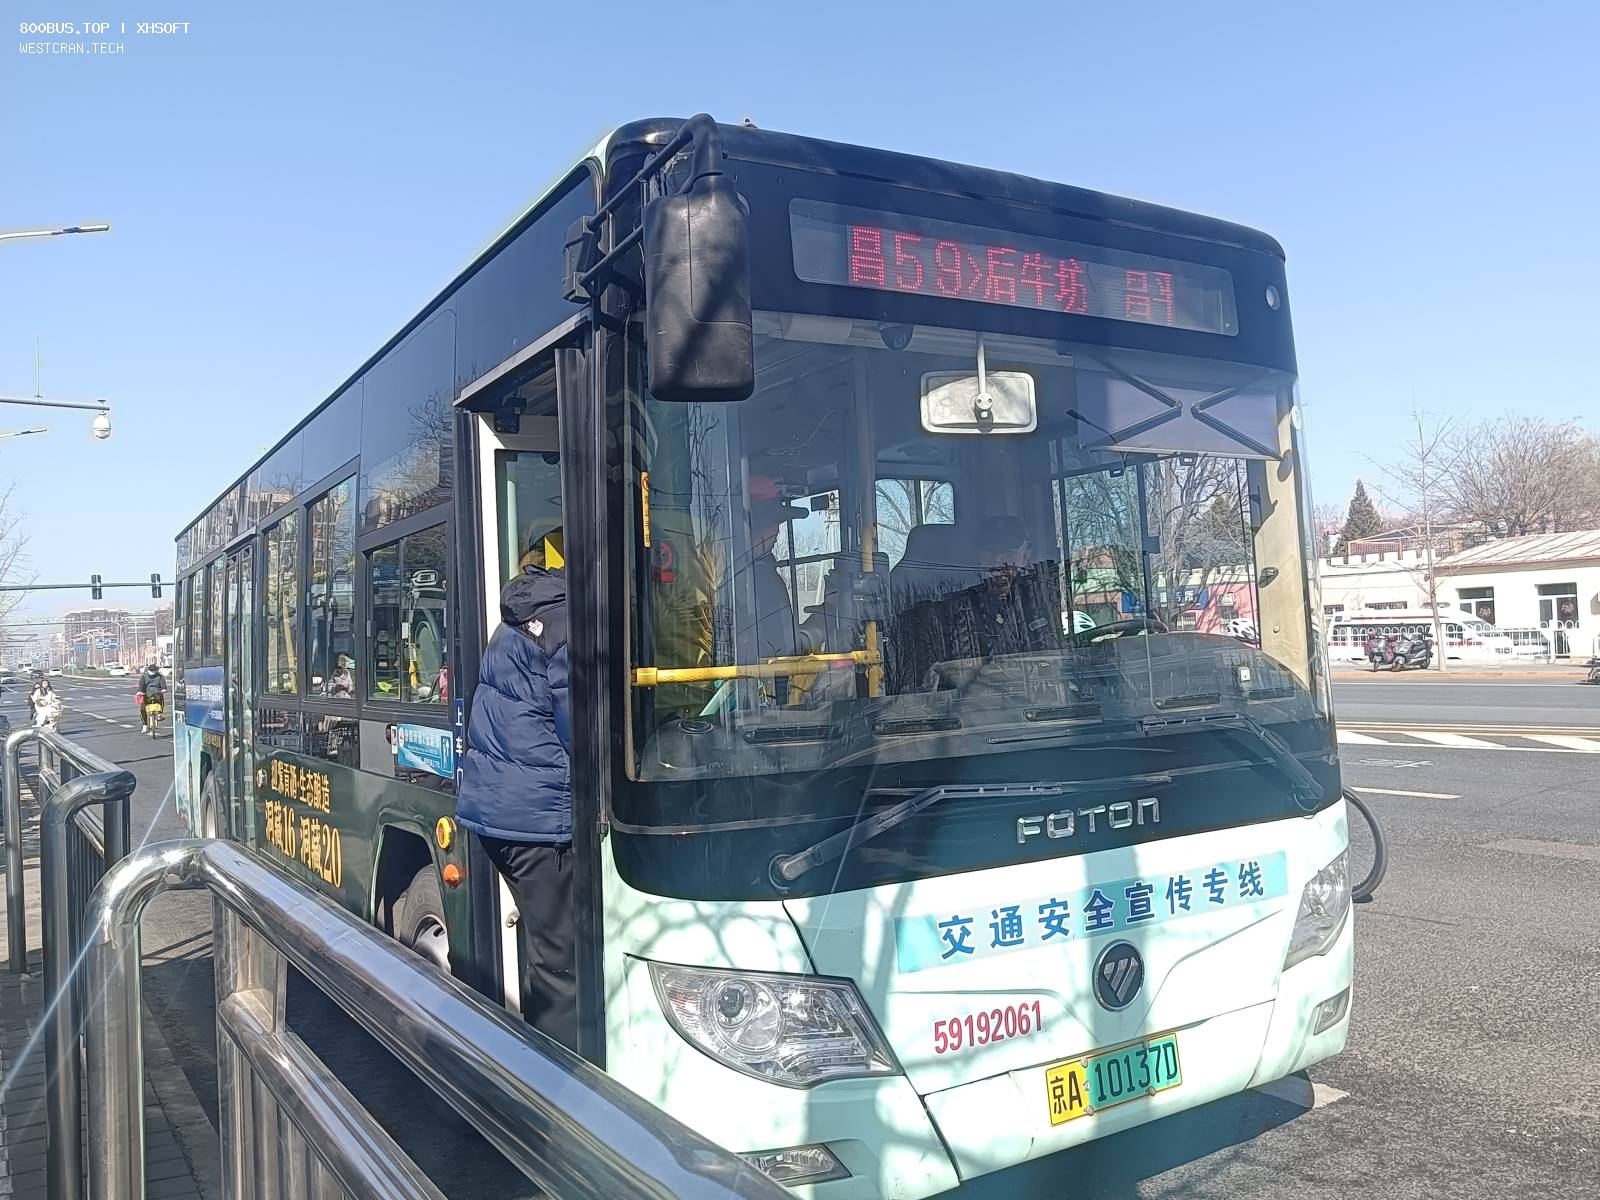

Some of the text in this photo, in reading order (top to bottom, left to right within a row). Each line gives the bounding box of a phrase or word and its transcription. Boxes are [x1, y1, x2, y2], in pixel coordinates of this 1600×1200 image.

[1016, 797, 1161, 844] FOTON
[937, 860, 1265, 960] 交通安全宣传专线
[934, 1000, 1043, 1055] 59192061
